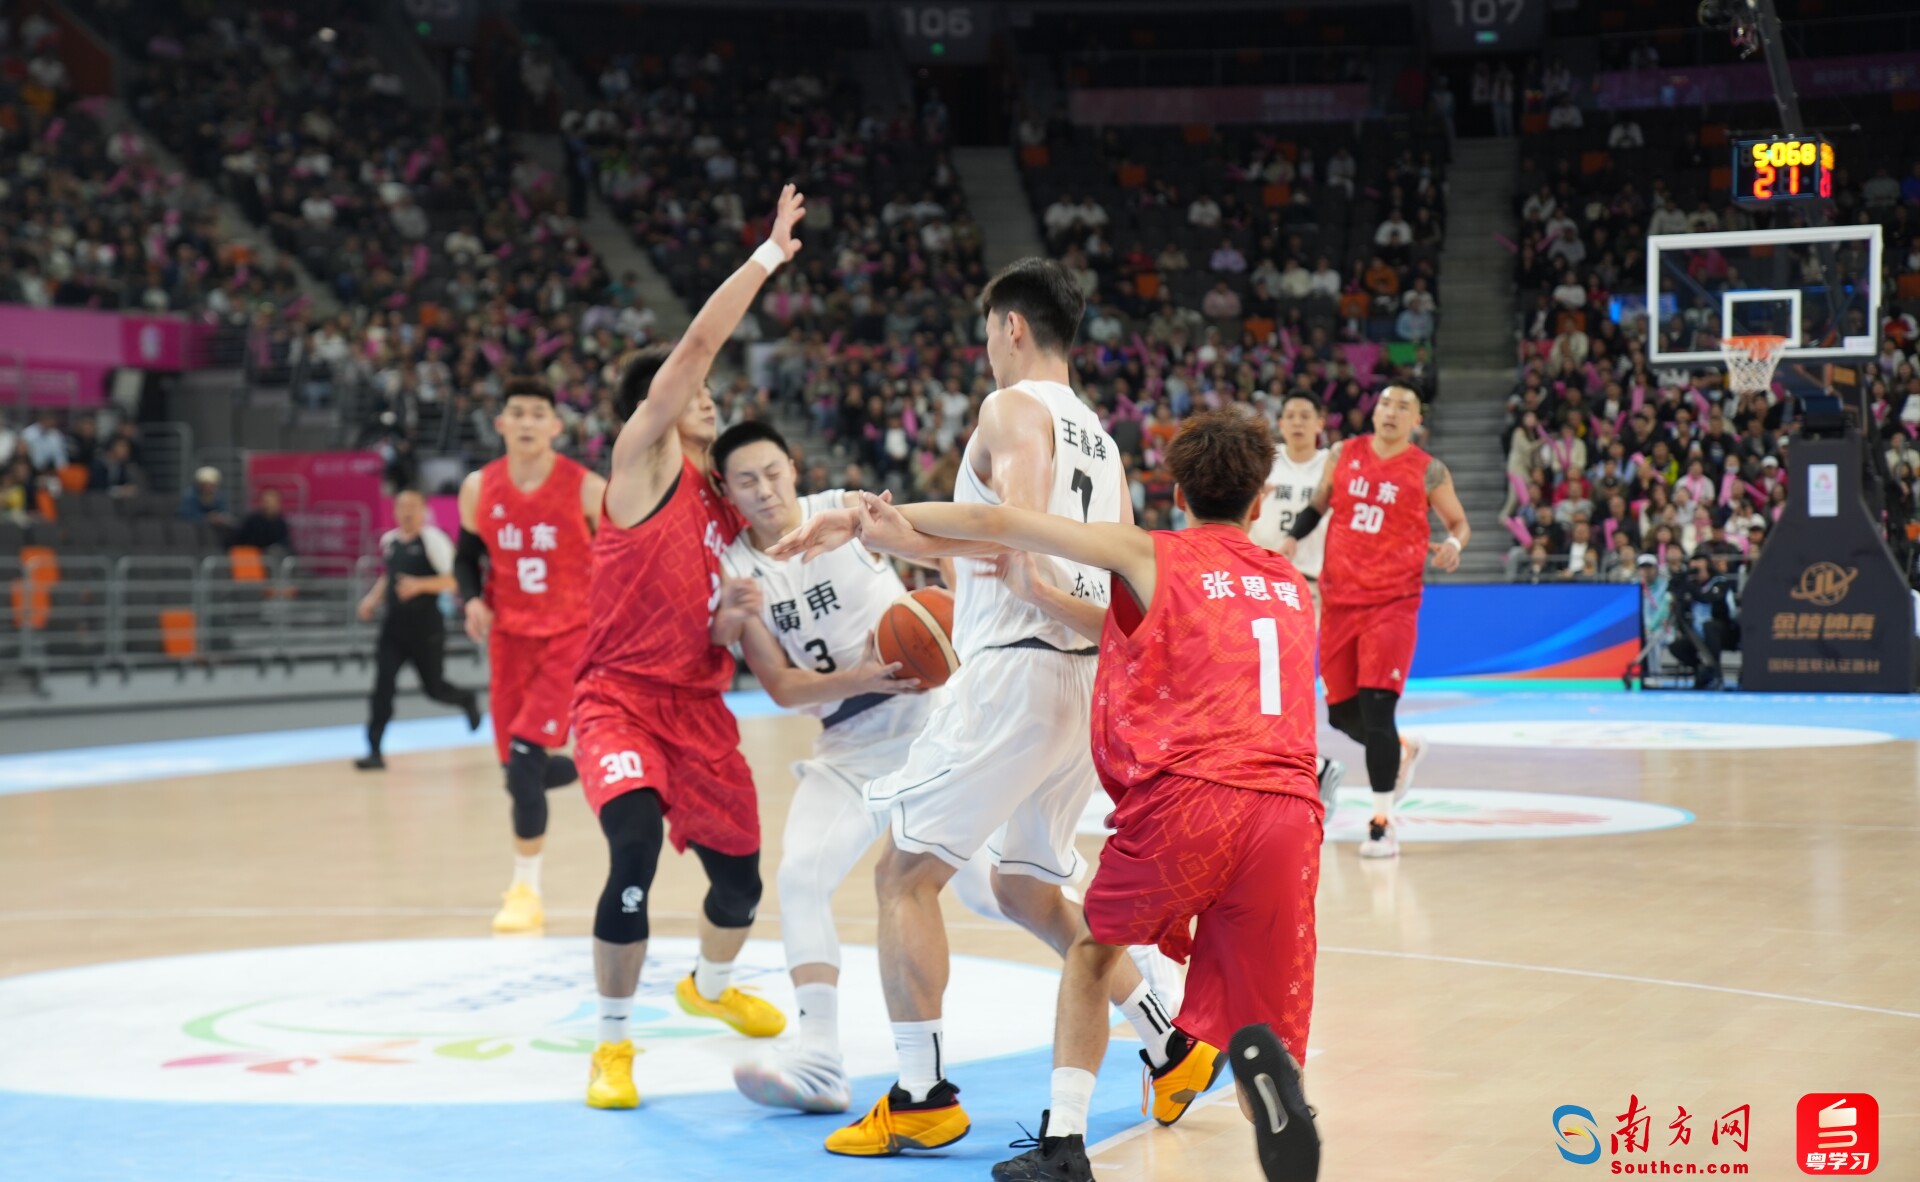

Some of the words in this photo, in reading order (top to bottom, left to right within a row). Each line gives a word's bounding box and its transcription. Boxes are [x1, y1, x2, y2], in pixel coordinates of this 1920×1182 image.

[901, 7, 973, 37] 106
[1451, 0, 1523, 25] 107
[1348, 476, 1399, 505] 山东
[1351, 502, 1385, 534] 20
[497, 522, 558, 552] 山东
[770, 580, 841, 633] 廣東
[1200, 570, 1301, 611] 张恩瑞
[804, 638, 837, 674] 3
[1251, 617, 1282, 715] 1
[599, 750, 644, 784] 30
